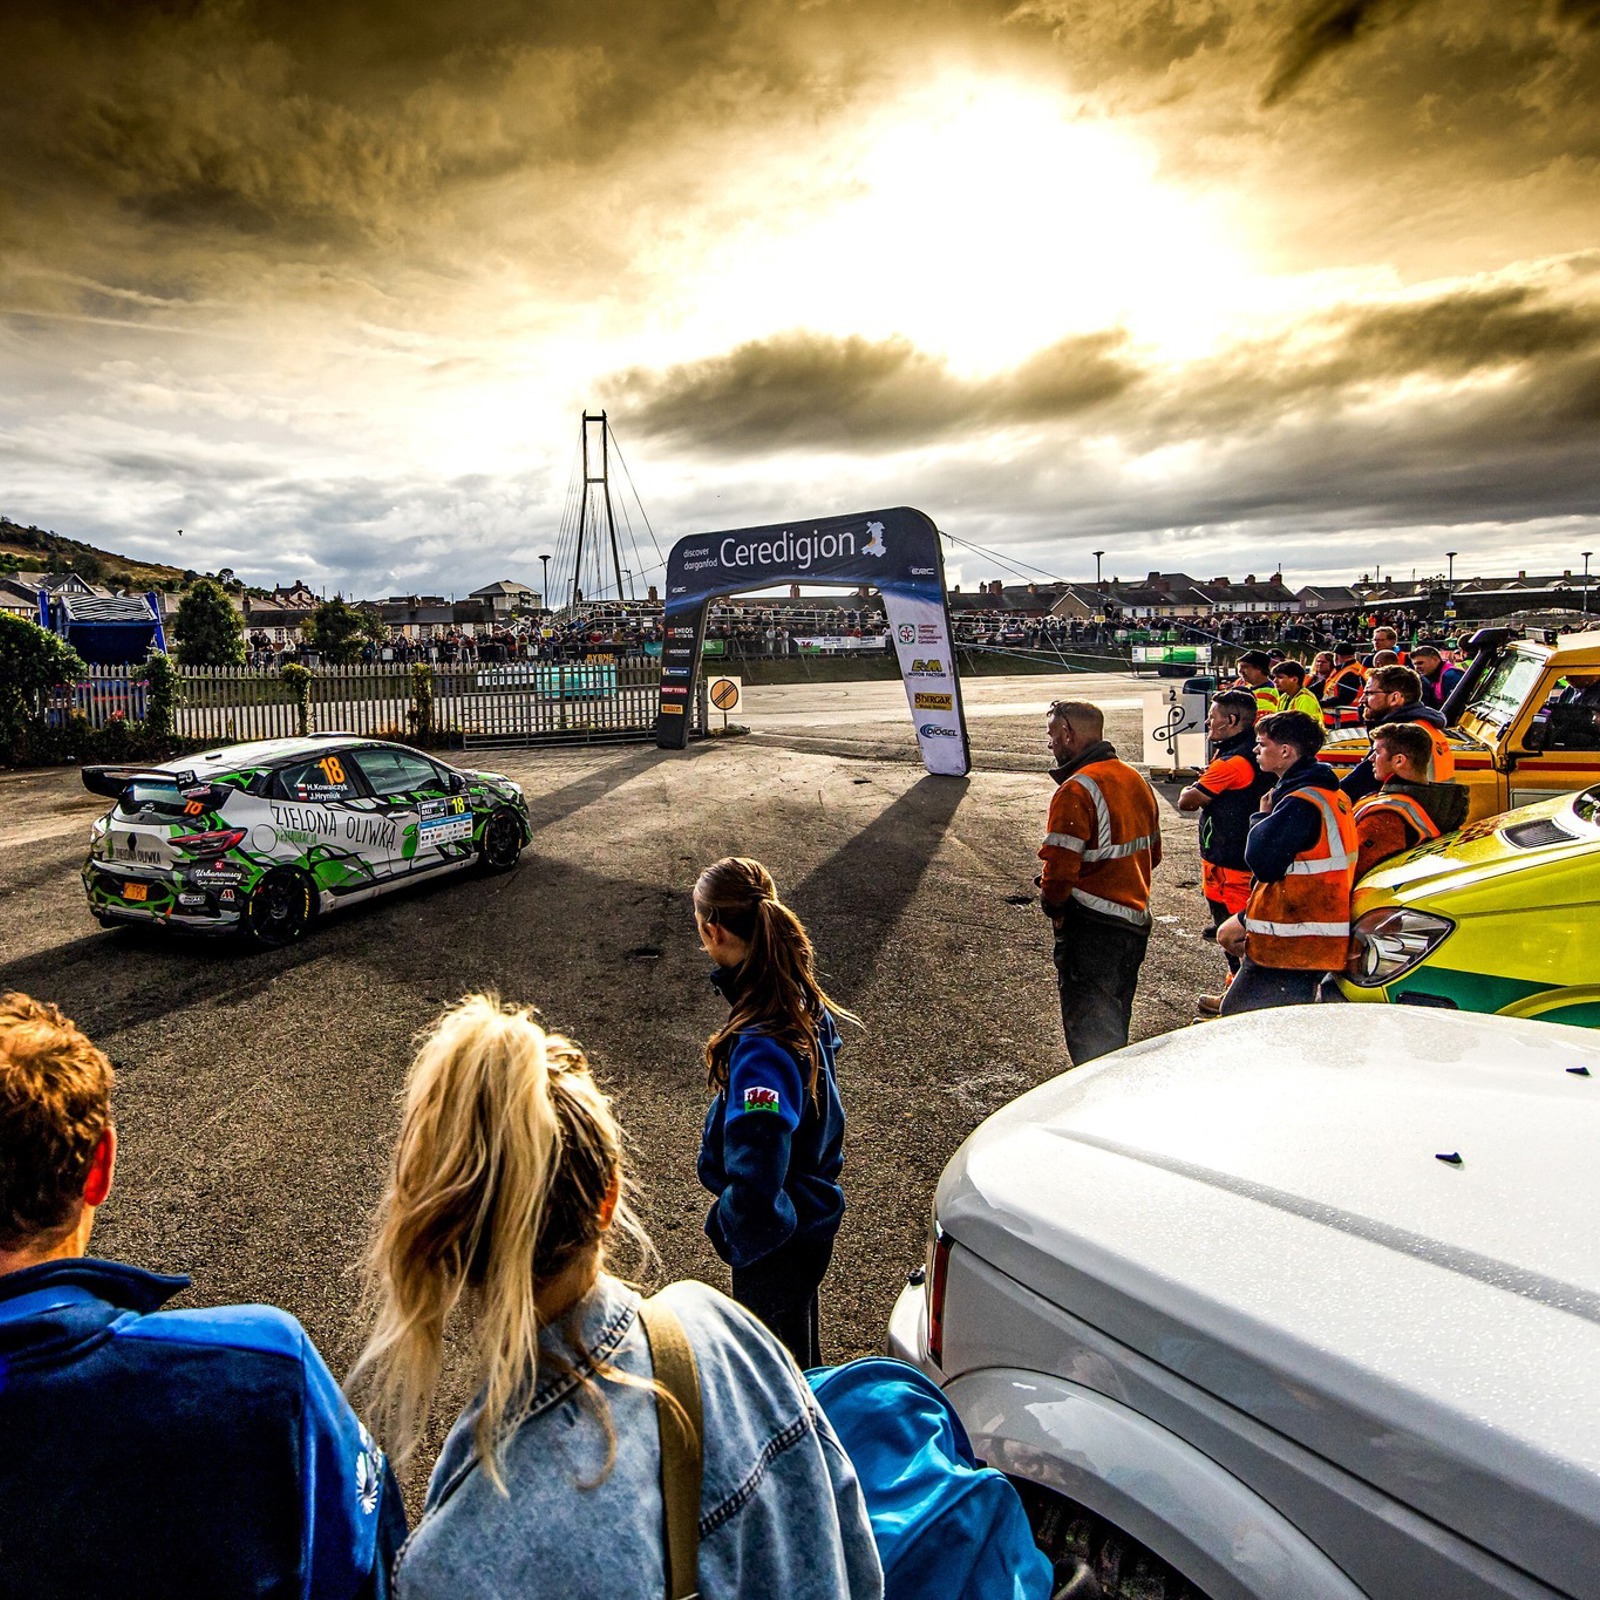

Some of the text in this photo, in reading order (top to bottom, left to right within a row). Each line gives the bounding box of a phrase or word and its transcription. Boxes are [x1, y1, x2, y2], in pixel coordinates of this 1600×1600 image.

[683, 548, 710, 558] discover
[720, 530, 855, 569] Ceredigion
[684, 558, 718, 571] darganfod
[1169, 690, 1177, 701] 2
[319, 756, 346, 785] 18
[306, 783, 349, 792] H.Kowalczyk
[309, 791, 342, 800] J.Hryniuk
[452, 797, 465, 814] 18
[271, 805, 337, 837] ZIELONA
